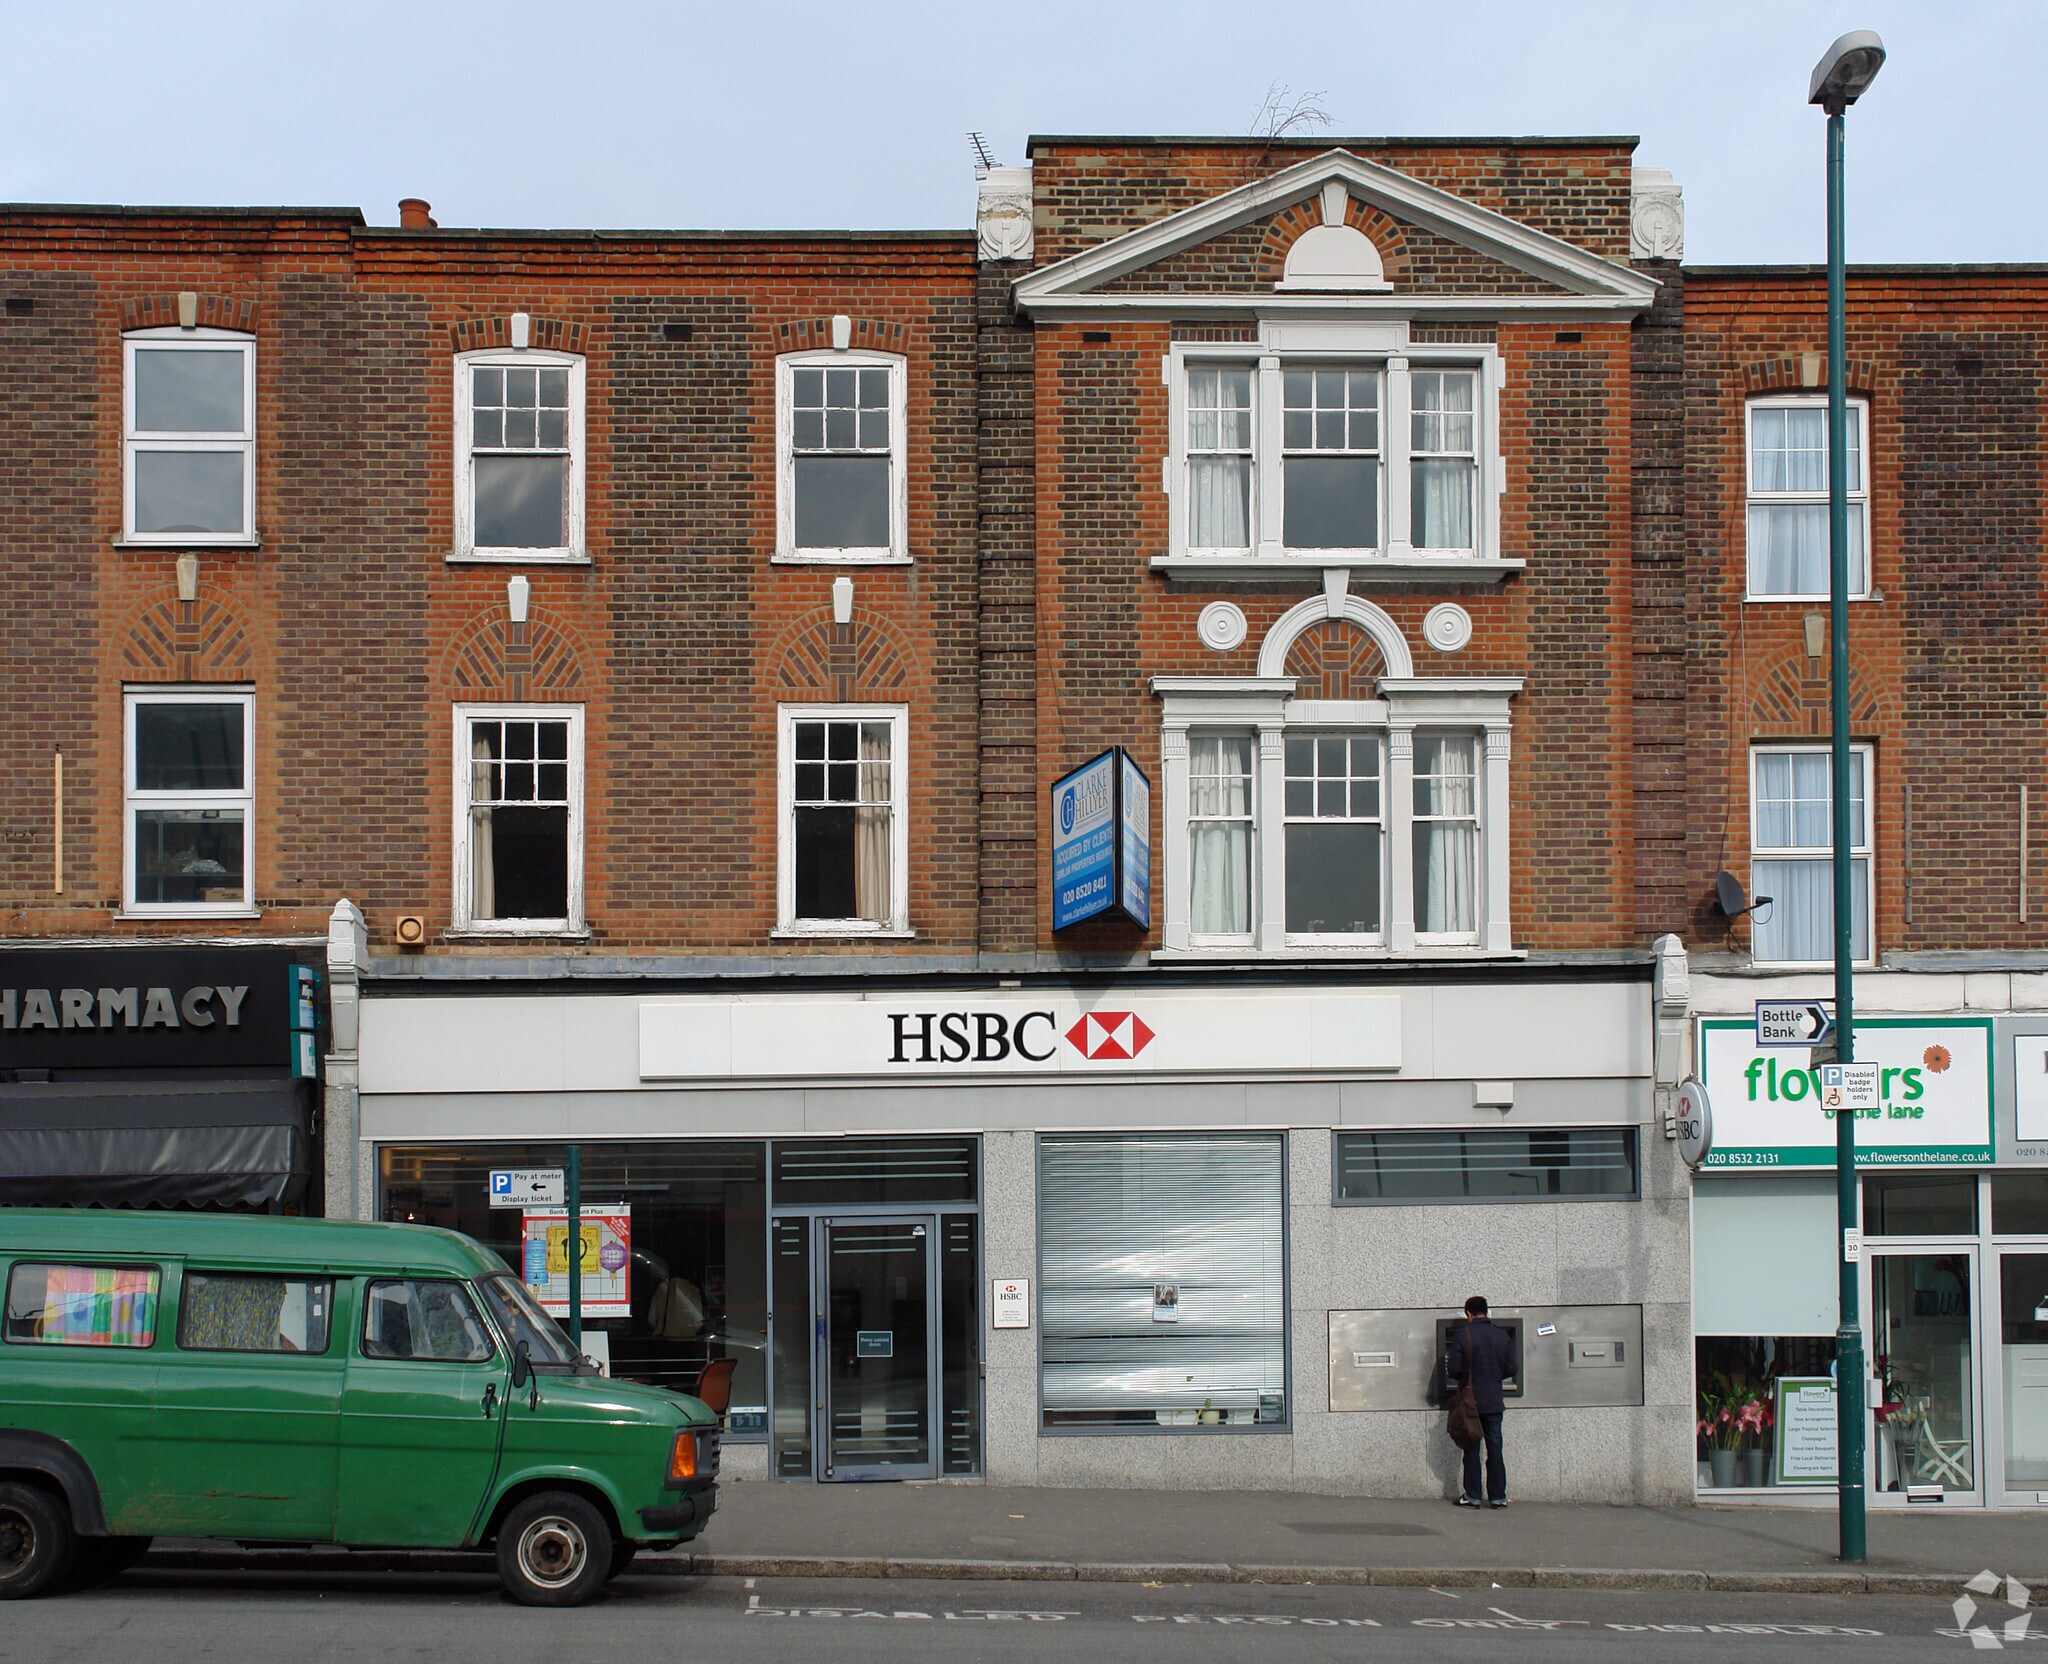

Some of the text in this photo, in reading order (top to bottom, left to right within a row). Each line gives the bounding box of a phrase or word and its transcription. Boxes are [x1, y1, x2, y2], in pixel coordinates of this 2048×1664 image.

[1075, 768, 1107, 801] CLARKE
[1075, 788, 1108, 821] HILLYER
[1083, 838, 1091, 853] BY
[1063, 889, 1075, 905] 020
[1075, 882, 1092, 900] 8520
[1092, 874, 1107, 893] 8411
[1762, 1010, 1804, 1022] Bottle
[887, 1011, 1057, 1063] HSBC
[1762, 1026, 1796, 1038] Bank
[1744, 1057, 1924, 1102] flors
[1827, 1068, 1840, 1085] P
[1887, 1103, 1925, 1120] lane
[1707, 1151, 1991, 1165] 020 8532 2131 ww.flowersonthelane.co.uk
[2016, 1148, 2036, 1156] 020
[495, 1175, 508, 1192] P
[514, 1173, 528, 1182] Pay
[501, 1195, 528, 1204] Display
[1847, 1244, 1858, 1252] 30
[999, 1292, 1023, 1301] HSBC
[744, 1608, 1067, 1621] DISABLED
